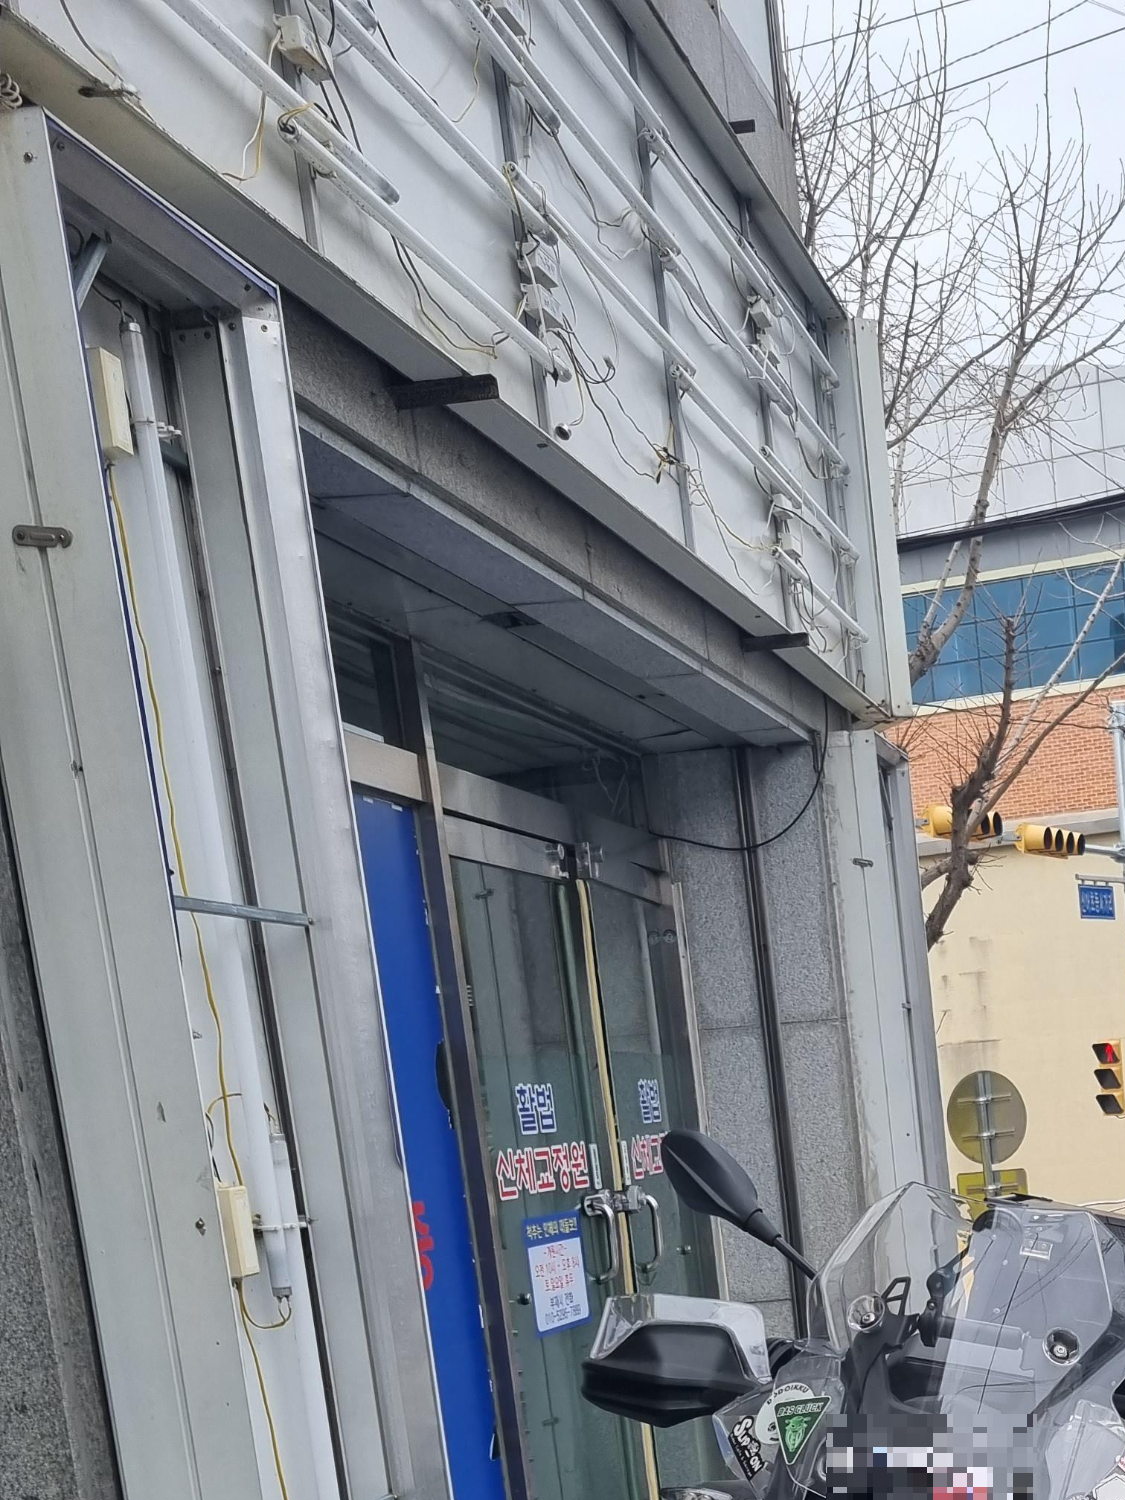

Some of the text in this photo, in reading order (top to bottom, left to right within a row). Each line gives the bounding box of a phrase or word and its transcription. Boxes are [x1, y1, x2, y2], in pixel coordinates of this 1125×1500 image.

[515, 1083, 557, 1135] 활법
[637, 1078, 662, 1124] 활법
[496, 1141, 589, 1201] 신체교정원
[631, 1131, 666, 1180] 신체교
